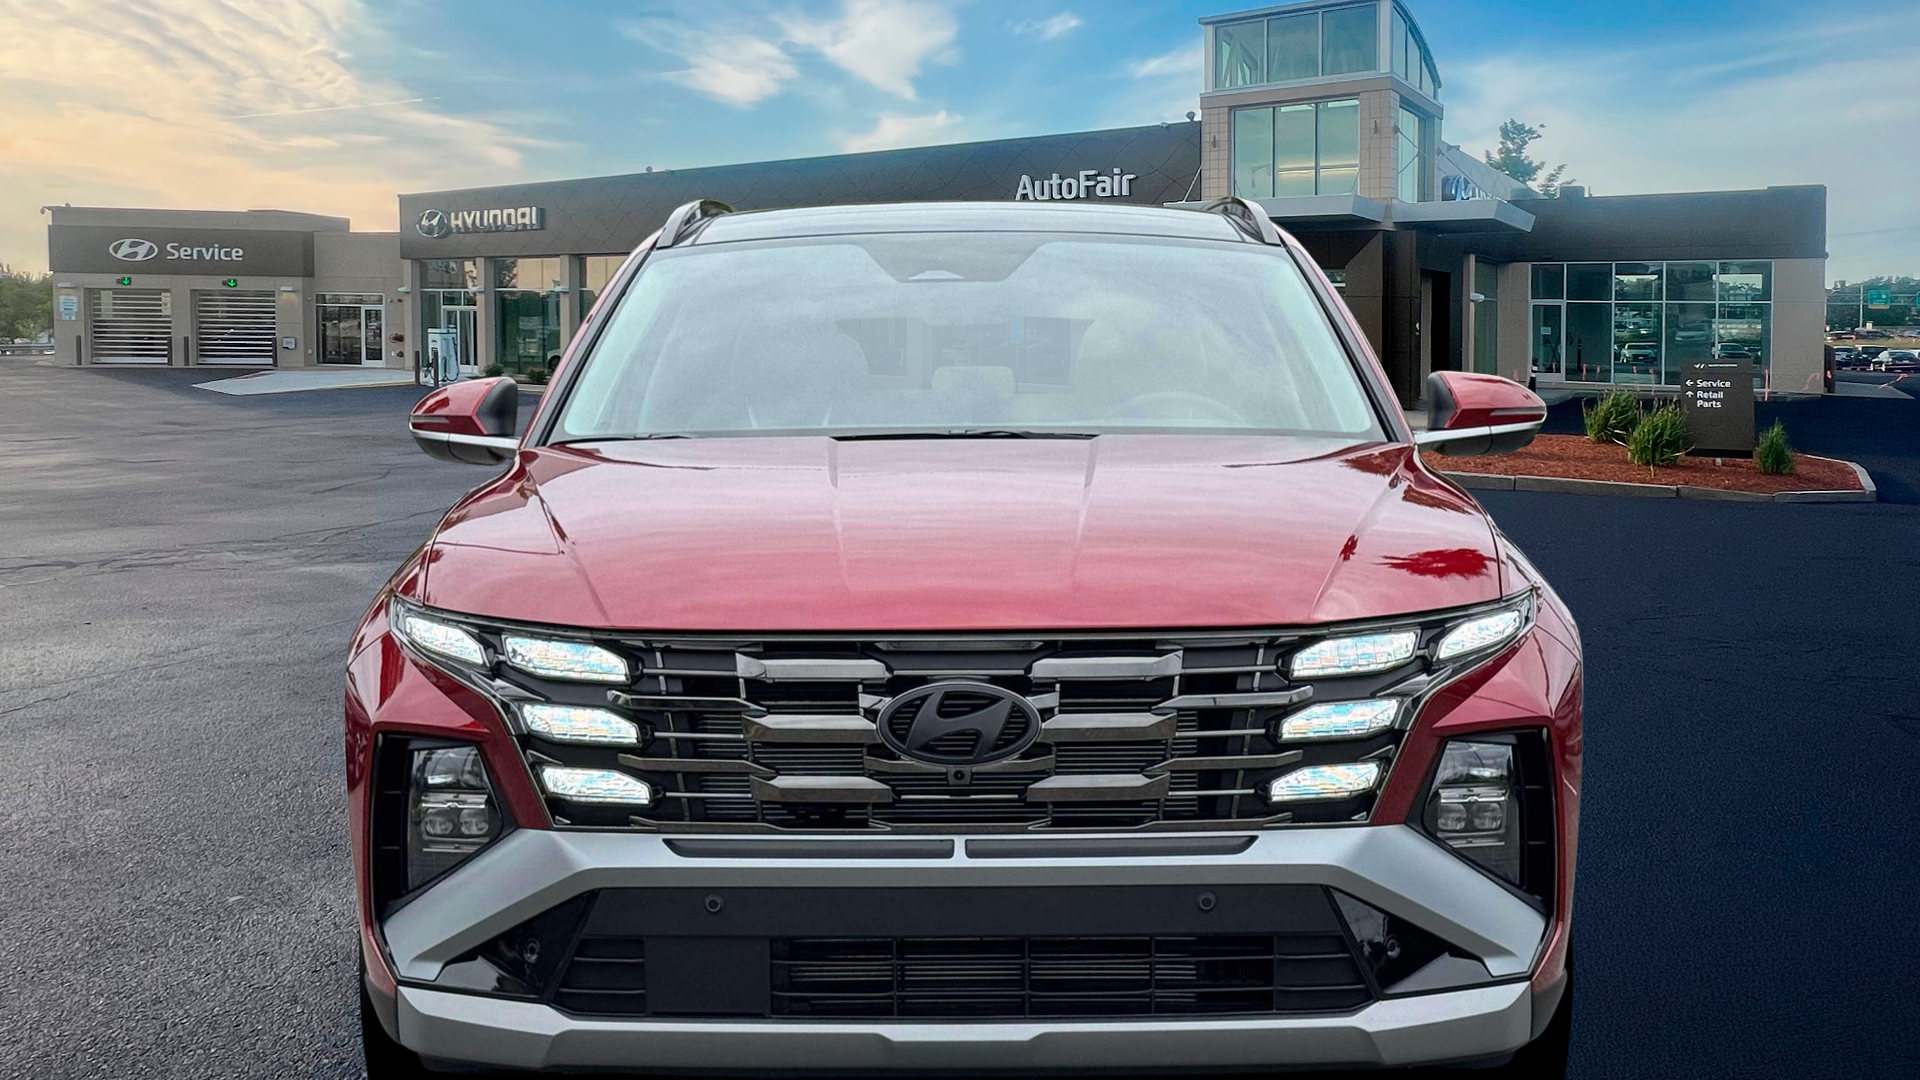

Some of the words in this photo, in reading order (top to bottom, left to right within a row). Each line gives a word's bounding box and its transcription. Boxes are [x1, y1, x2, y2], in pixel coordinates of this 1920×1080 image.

[1015, 168, 1137, 200] AutoFair
[450, 206, 540, 233] HYUNDAI
[166, 242, 244, 261] Service
[1696, 379, 1731, 388] Service
[1696, 390, 1724, 399] Retail
[1696, 400, 1722, 408] Parts
